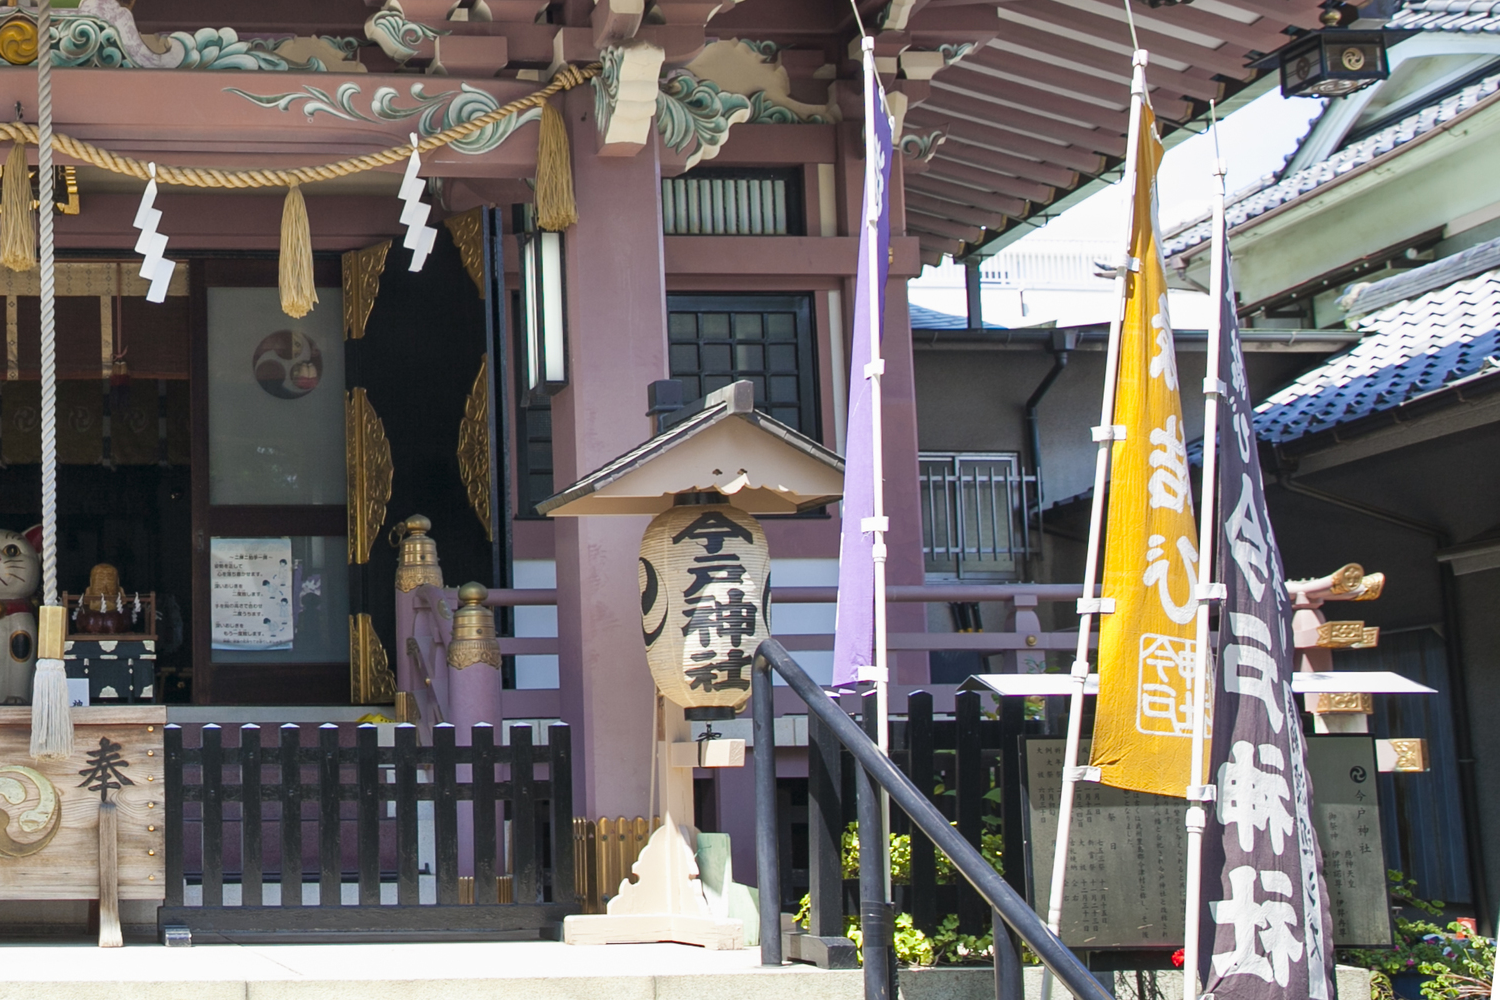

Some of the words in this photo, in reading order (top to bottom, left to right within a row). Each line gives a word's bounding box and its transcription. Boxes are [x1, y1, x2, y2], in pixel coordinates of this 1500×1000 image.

[672, 510, 756, 693] 今戸神社
[78, 737, 134, 801] 奉
[1354, 789, 1372, 854] 今戸神社
